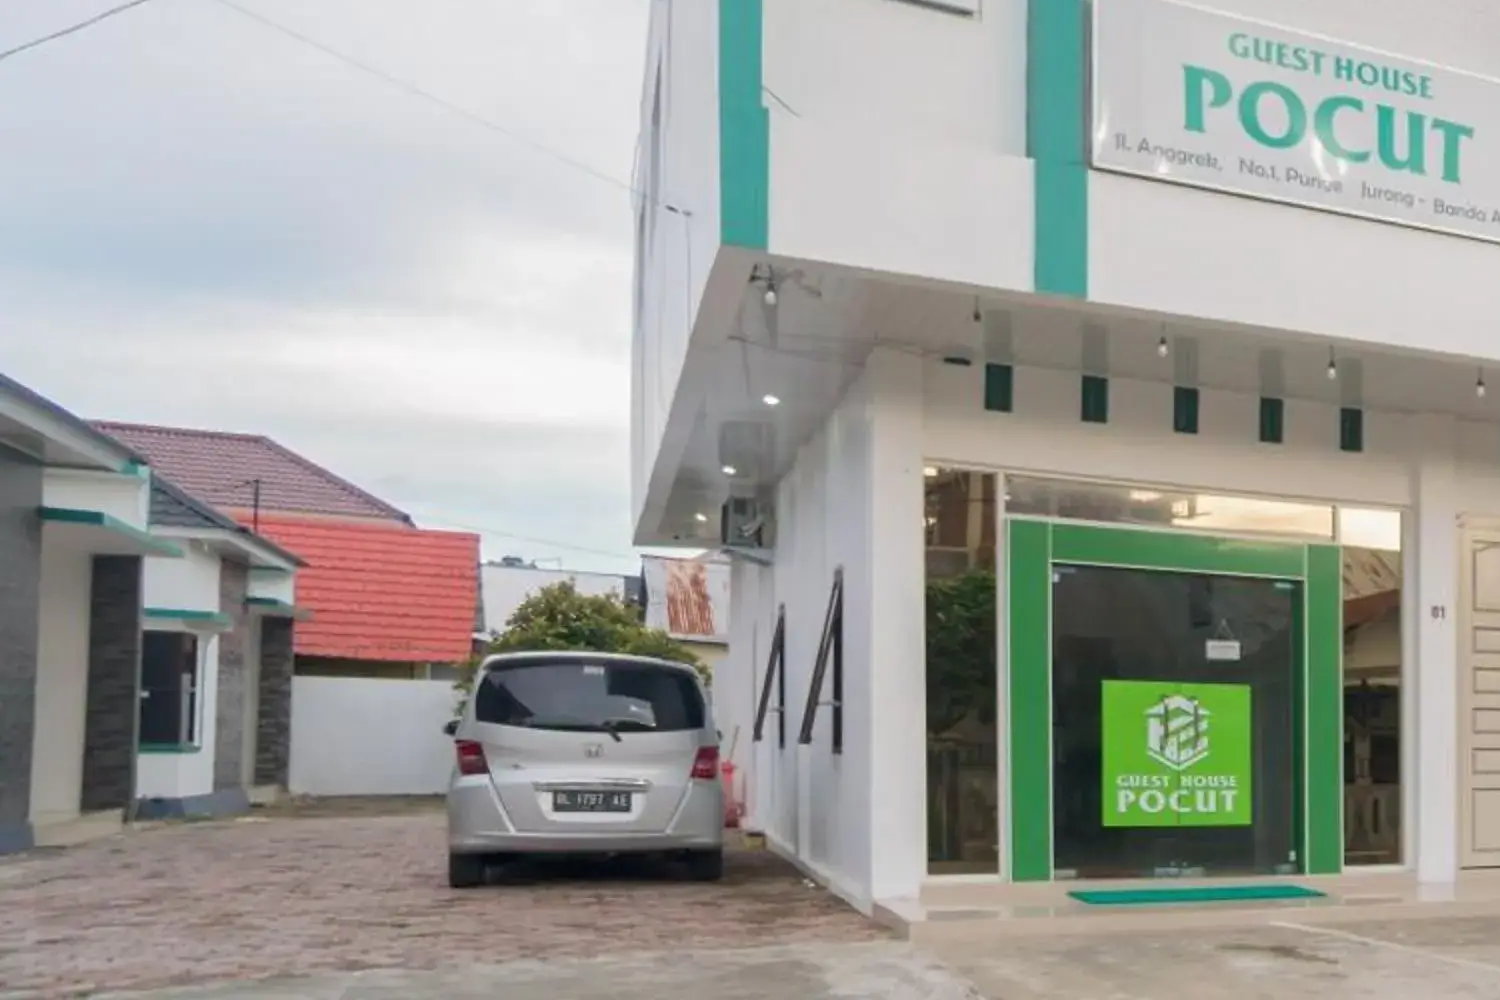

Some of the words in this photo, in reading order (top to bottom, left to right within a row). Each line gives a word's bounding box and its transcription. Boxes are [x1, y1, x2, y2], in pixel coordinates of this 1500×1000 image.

[1228, 32, 1326, 77] GUEST
[1335, 56, 1434, 99] HOUSE
[1181, 63, 1475, 185] POCUT
[1361, 180, 1414, 208] Jurong
[1434, 197, 1487, 223] Banda
[1116, 775, 1170, 787] GUEST
[1180, 775, 1238, 787] HOUSE
[1117, 789, 1238, 813] POCUT
